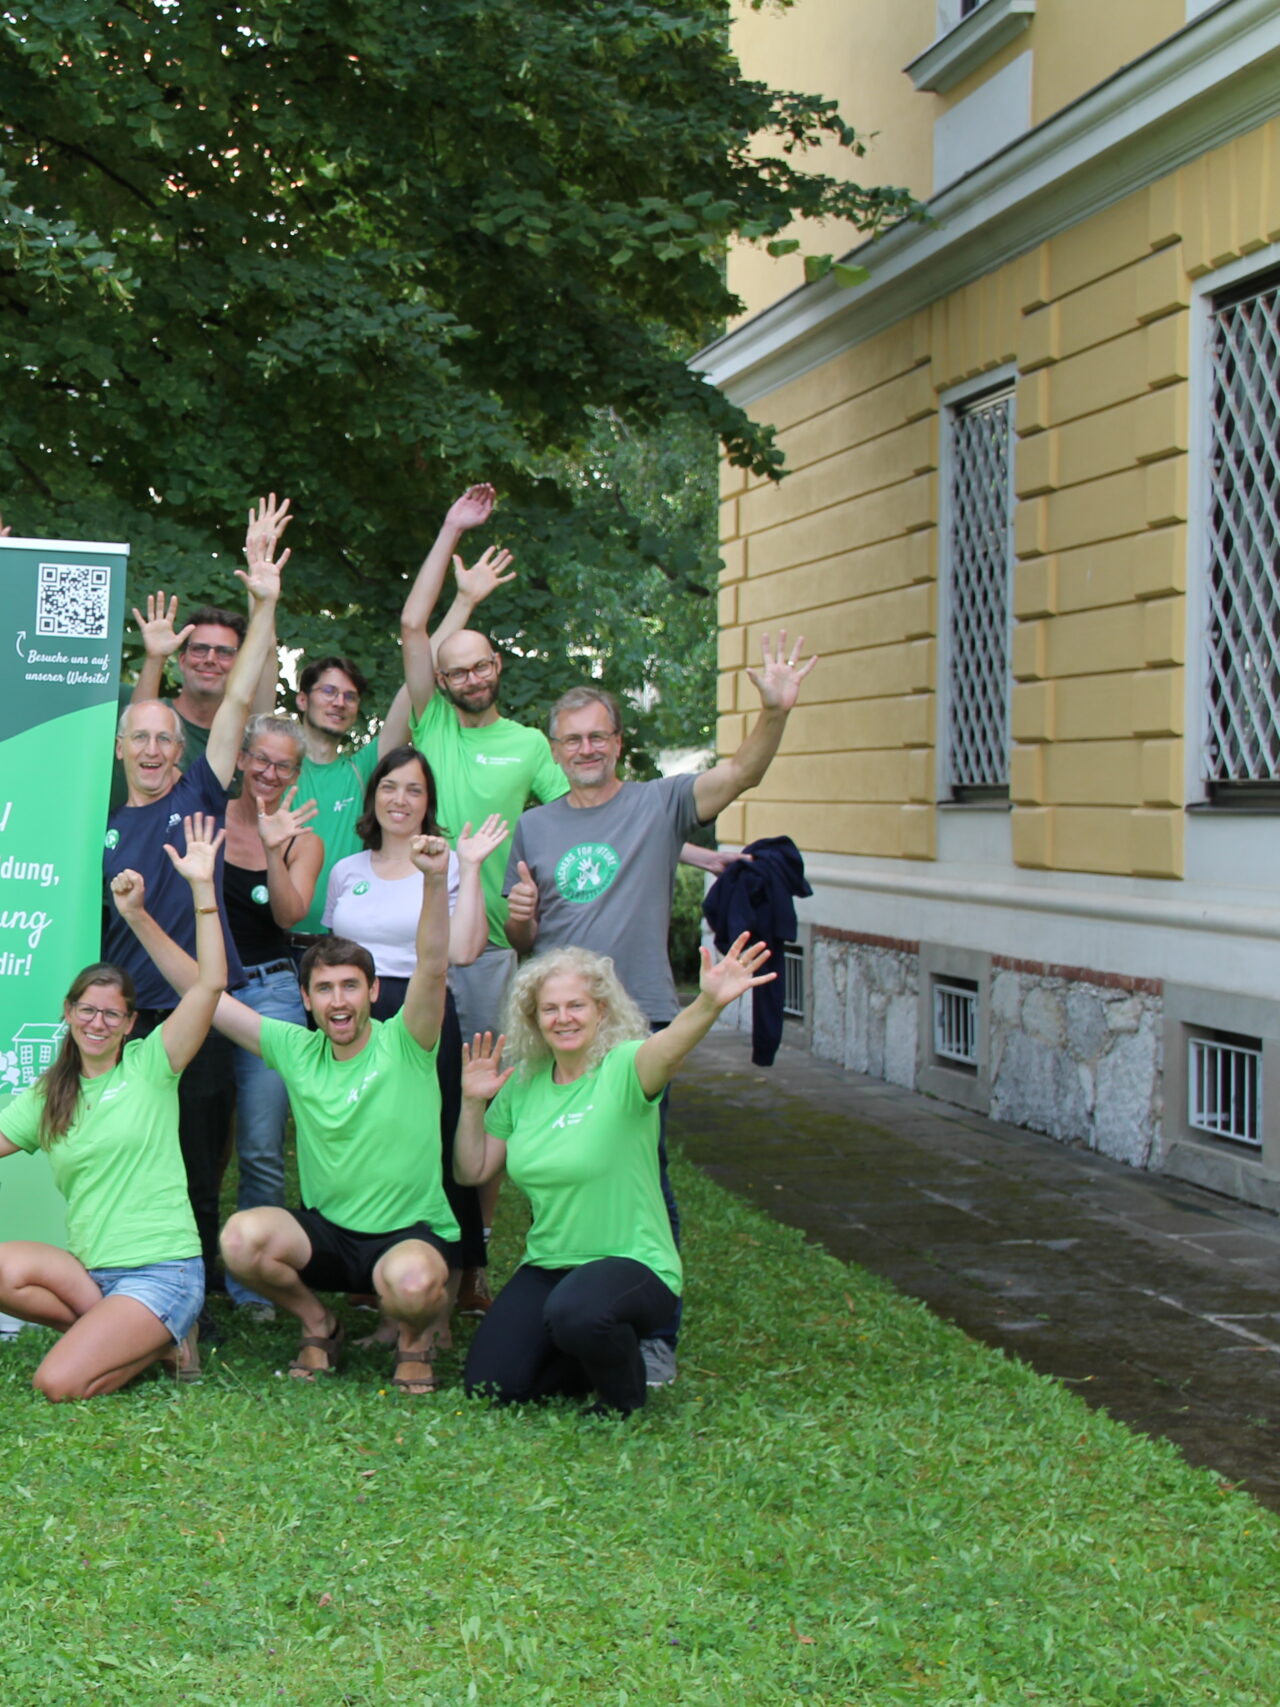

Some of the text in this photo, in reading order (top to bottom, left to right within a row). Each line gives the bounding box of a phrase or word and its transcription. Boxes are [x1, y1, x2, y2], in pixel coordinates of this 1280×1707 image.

[27, 649, 111, 671] Besuche uns auf
[25, 670, 110, 685] unserer Website!
